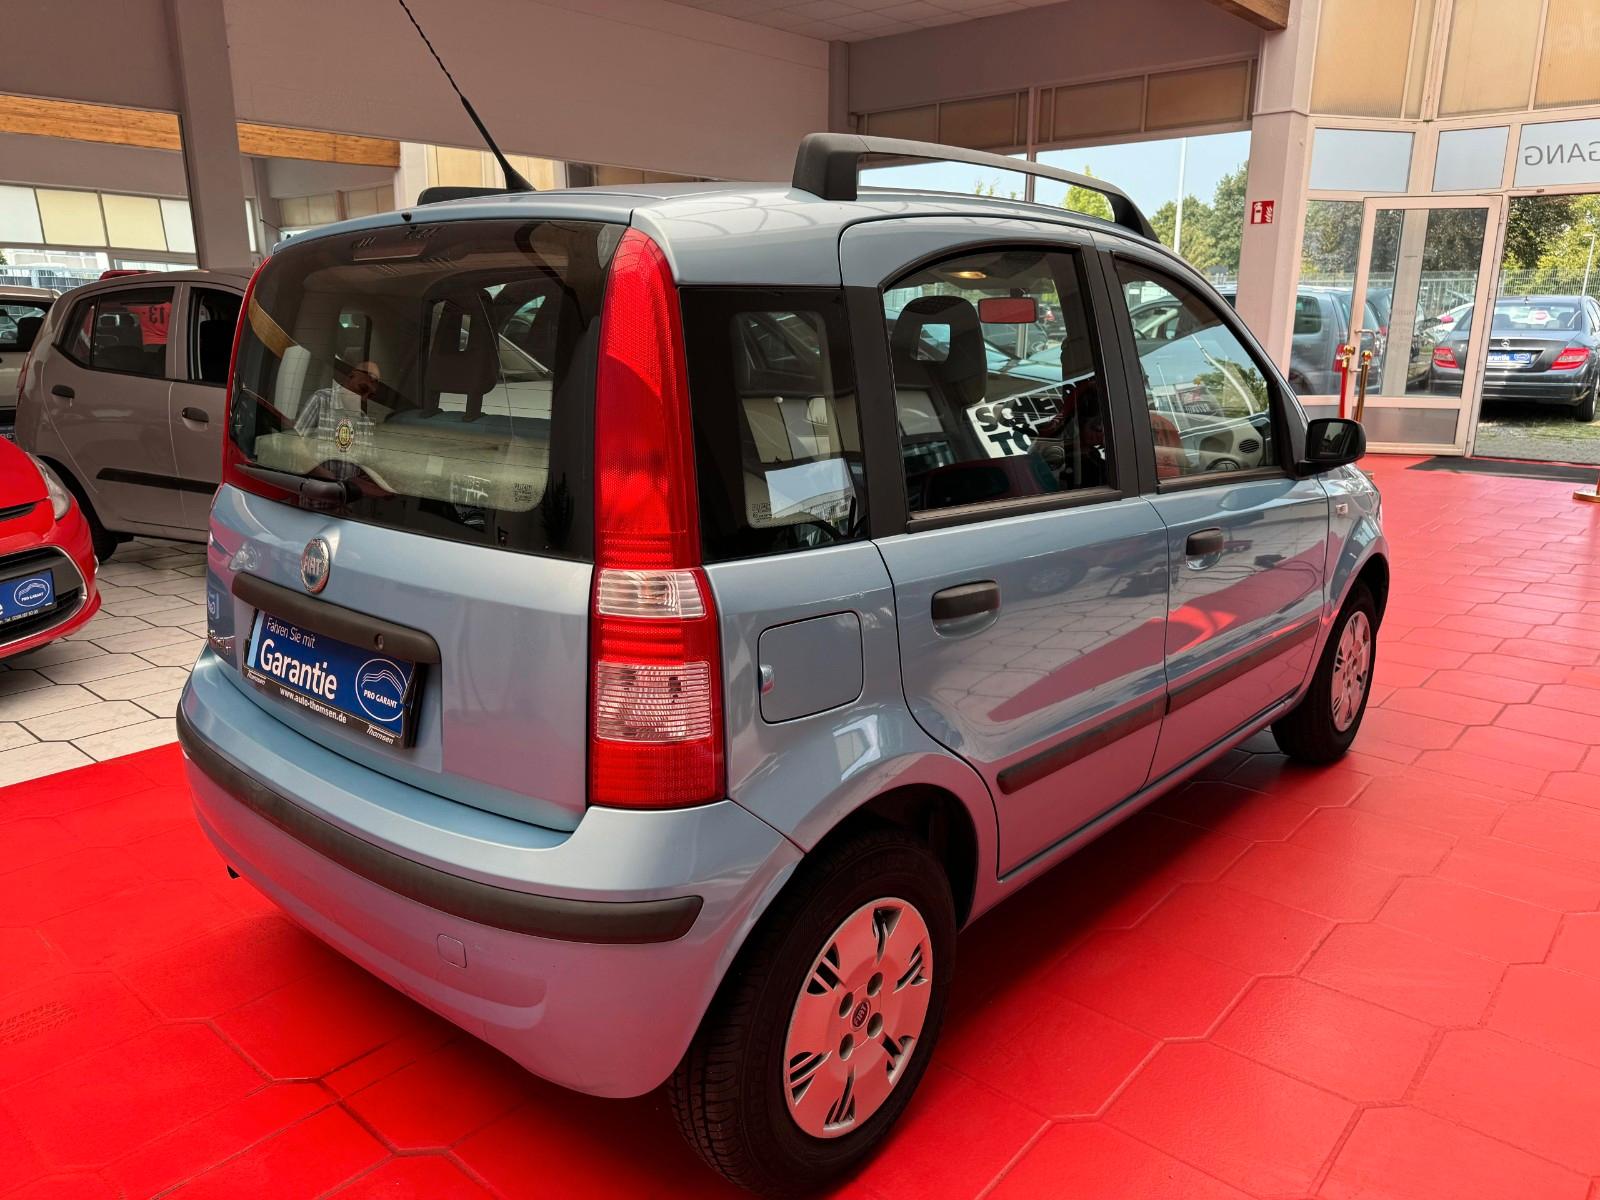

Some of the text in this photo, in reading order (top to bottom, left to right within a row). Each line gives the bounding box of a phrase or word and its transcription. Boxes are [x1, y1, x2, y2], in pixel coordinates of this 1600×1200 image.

[266, 617, 316, 649] Fahren Sie mit
[260, 638, 337, 700] Garantie
[279, 686, 347, 725] www.auto-thomsen.de
[363, 689, 398, 709] PRO GARANT
[366, 724, 394, 745] Thomsen
